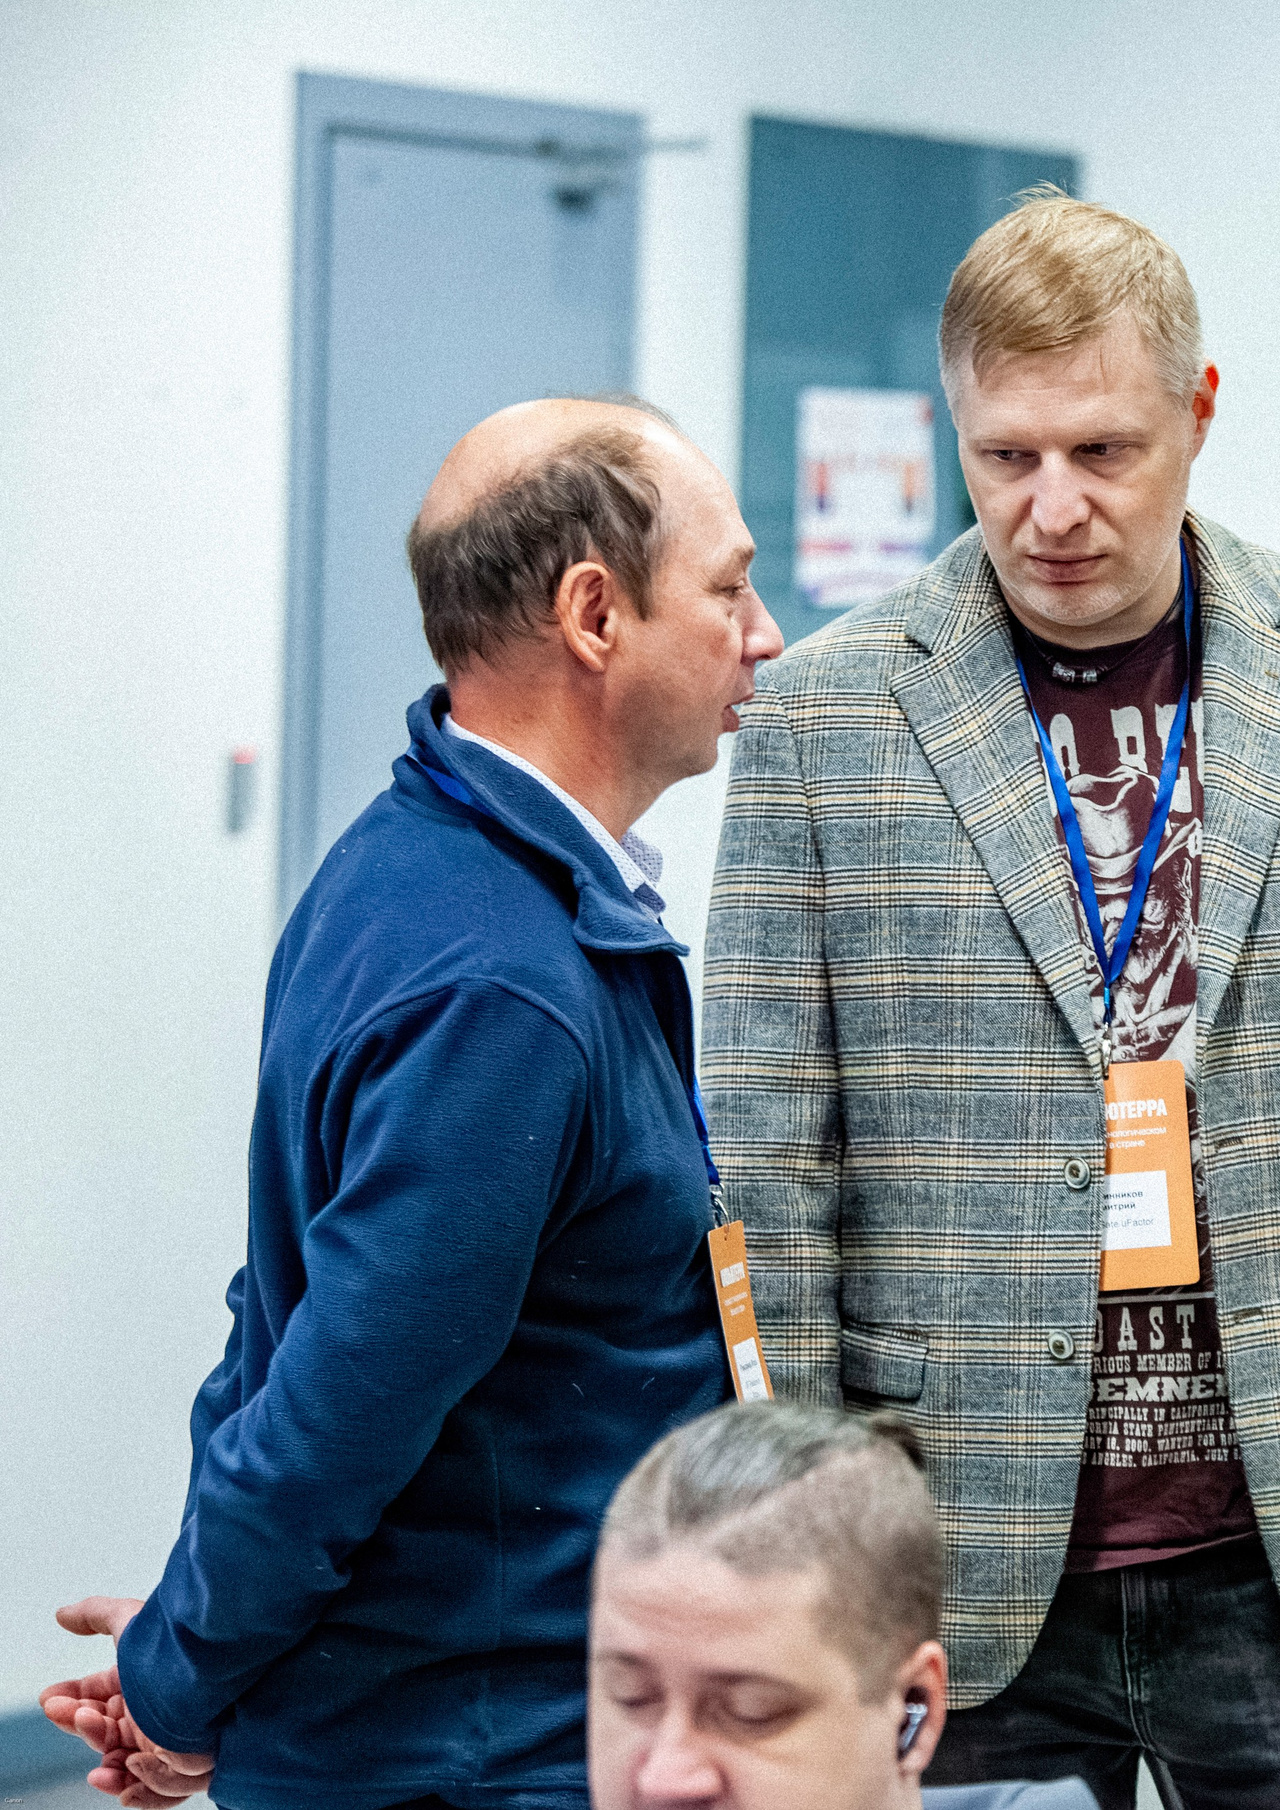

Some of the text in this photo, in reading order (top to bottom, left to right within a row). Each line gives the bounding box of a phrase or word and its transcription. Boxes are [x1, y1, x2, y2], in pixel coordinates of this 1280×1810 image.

[1136, 1352, 1192, 1372] MEMBER
[1197, 1351, 1212, 1370] OF
[1153, 1408, 1166, 1422] IN
[1123, 1422, 1154, 1438] STATE
[1157, 1418, 1225, 1437] PENITENTIARY
[1157, 1435, 1194, 1452] WANTED
[1197, 1433, 1216, 1447] FOR
[1204, 1448, 1230, 1462] JULY
